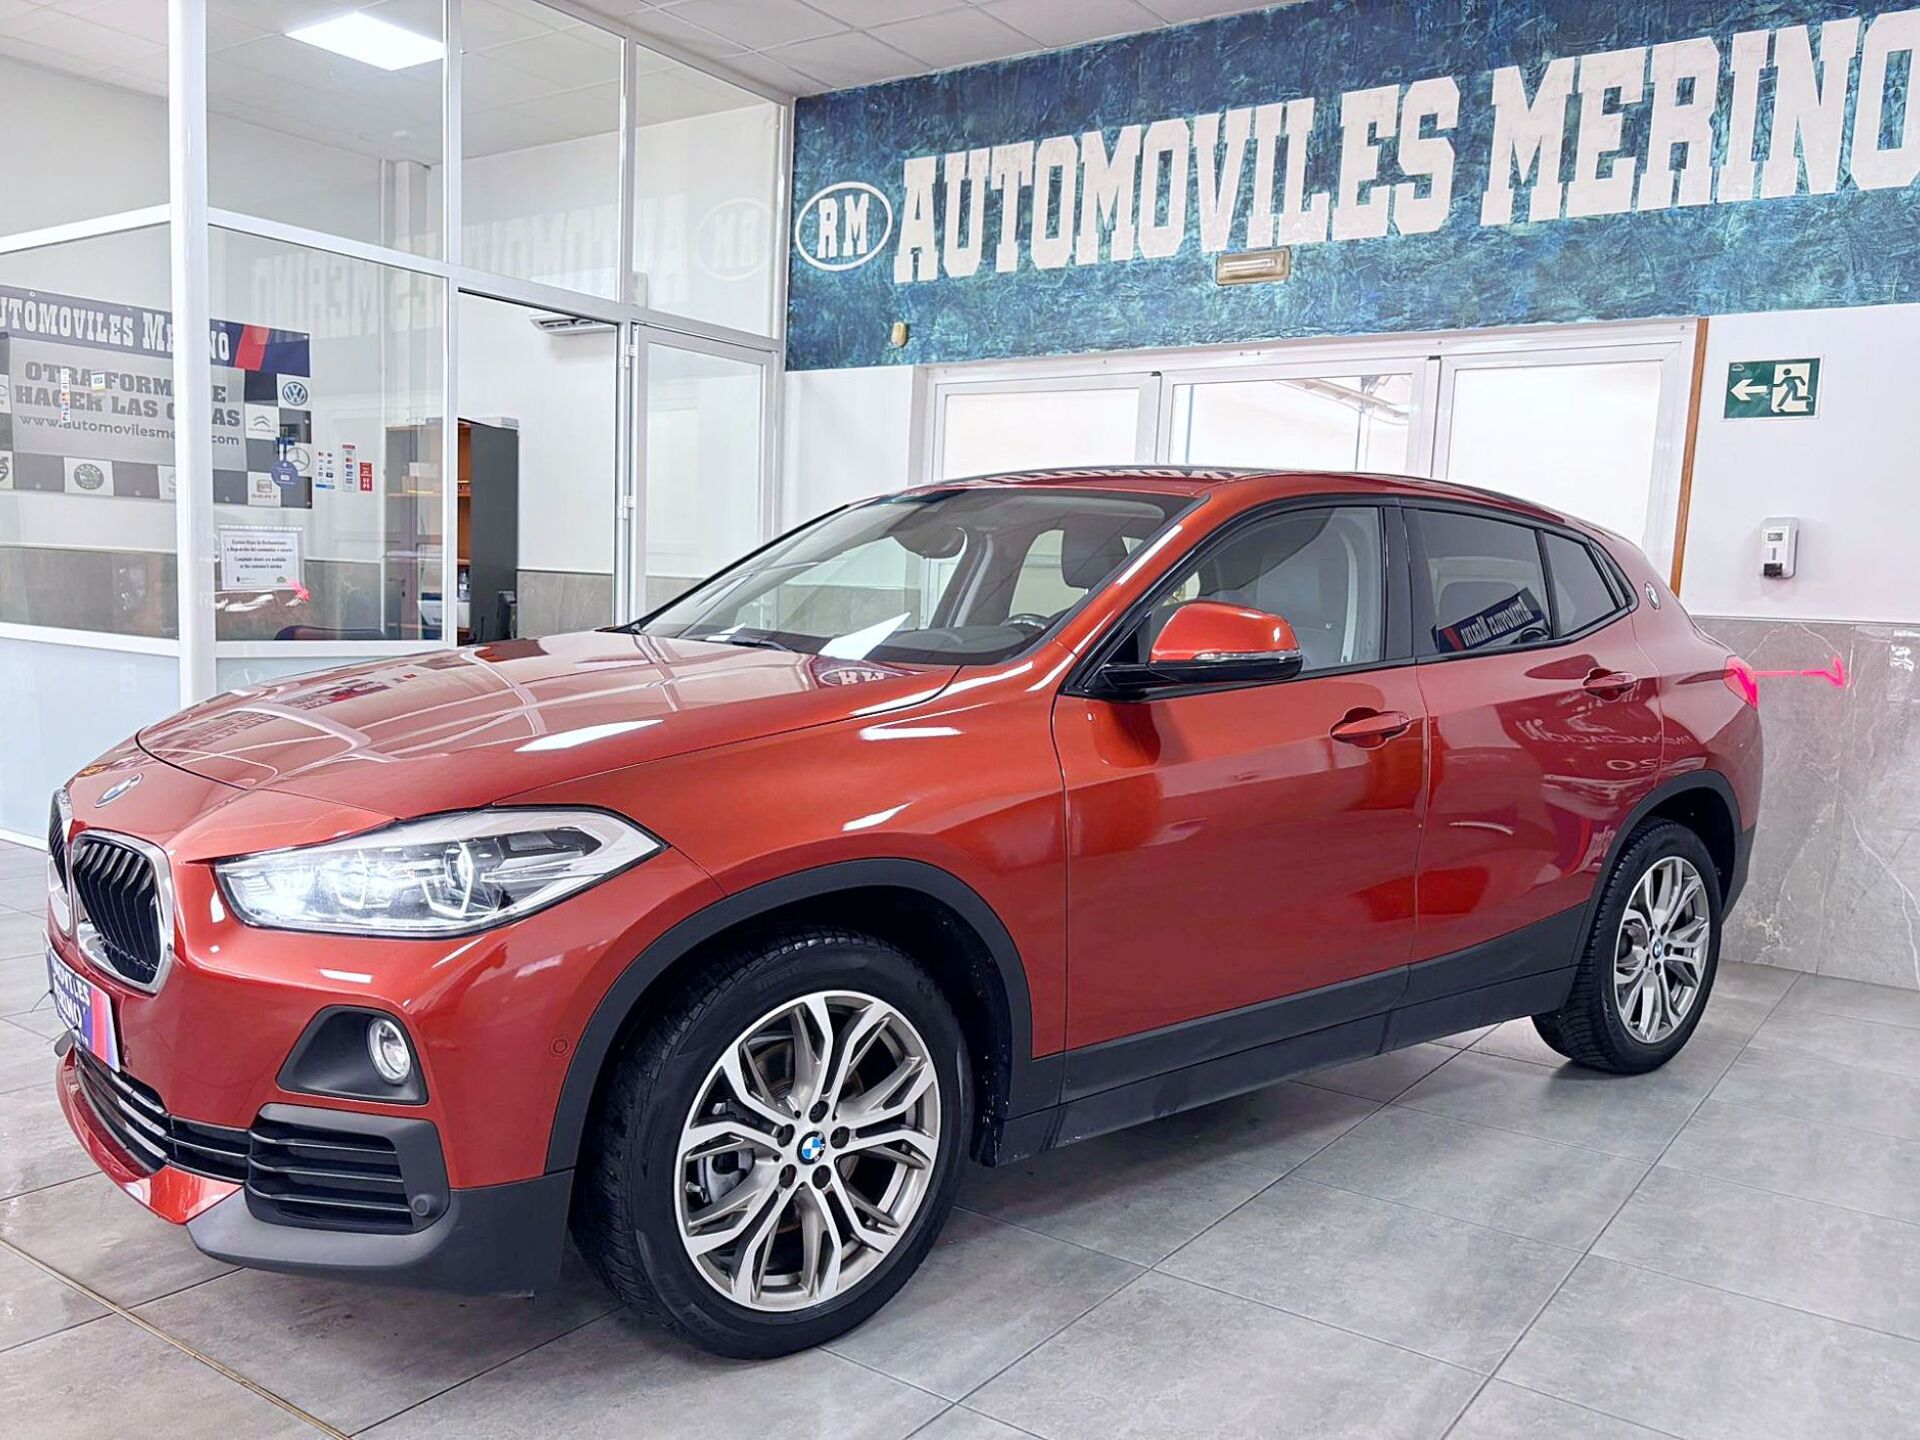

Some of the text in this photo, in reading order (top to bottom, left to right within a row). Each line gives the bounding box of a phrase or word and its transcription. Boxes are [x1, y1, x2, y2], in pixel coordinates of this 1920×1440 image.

[817, 8, 1920, 284] RM AUTOMOVILES MERINO
[104, 371, 173, 397] FORM
[111, 396, 158, 418] LAS
[19, 415, 240, 446] www.automovilesmecom
